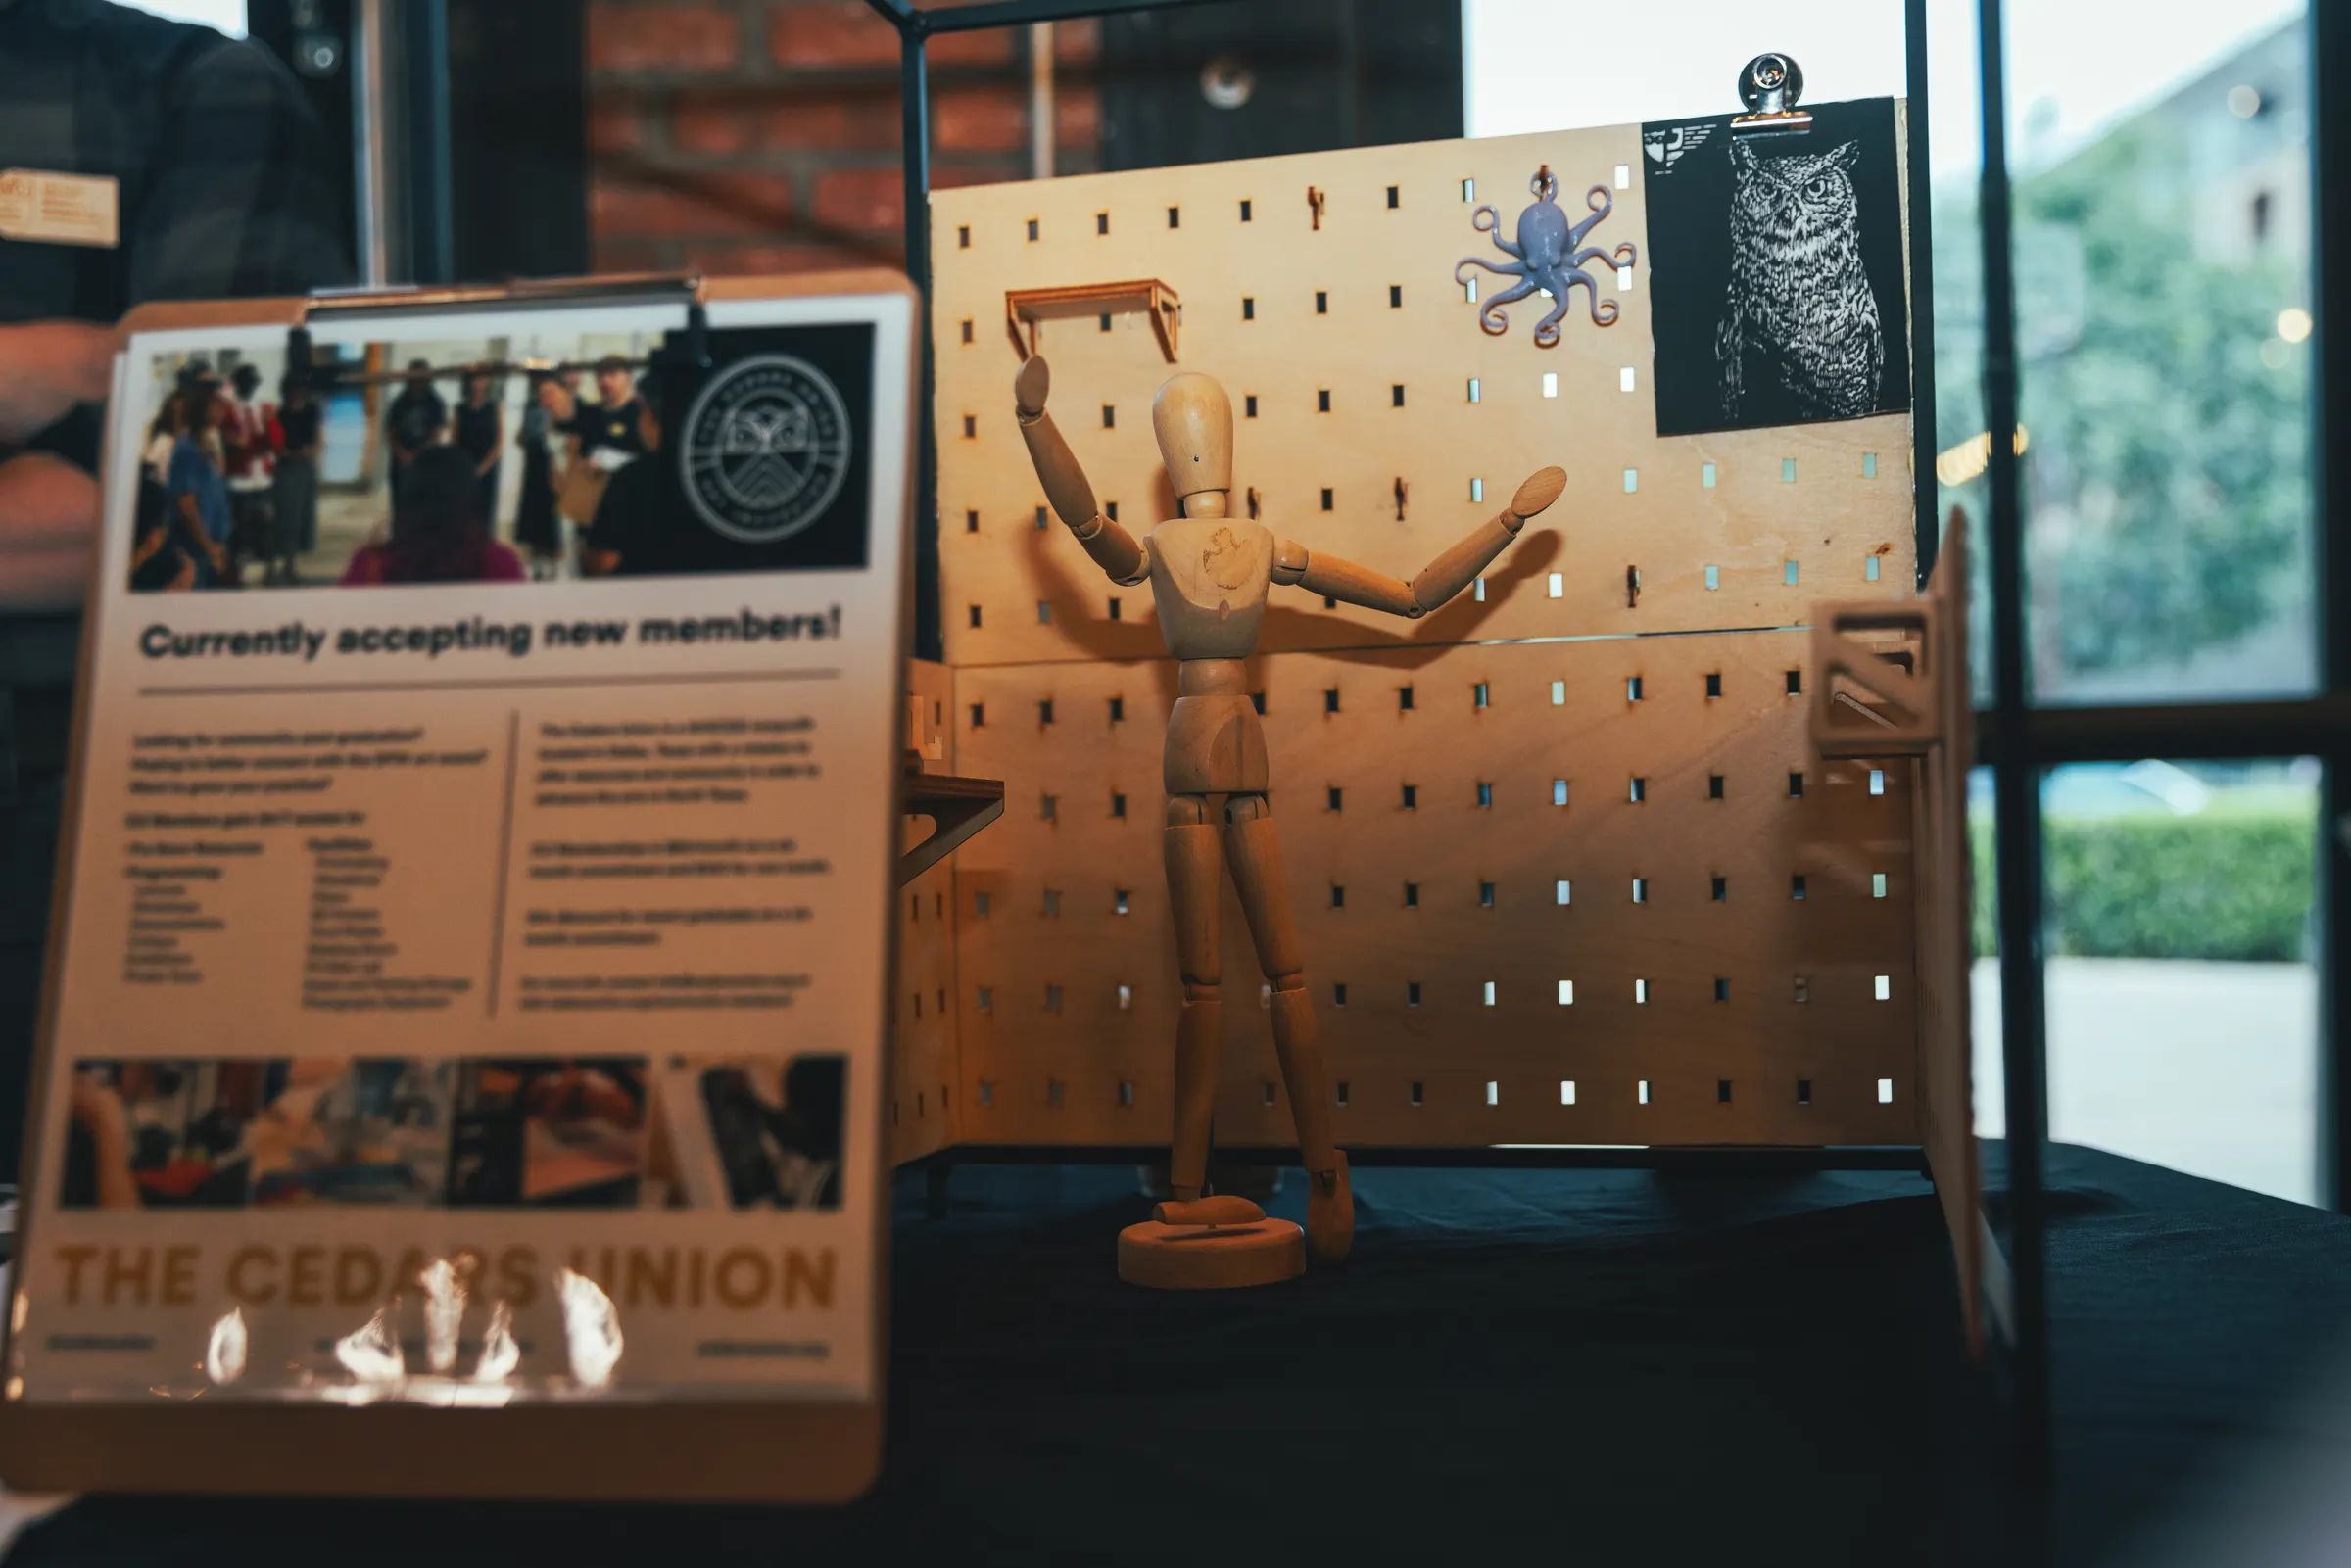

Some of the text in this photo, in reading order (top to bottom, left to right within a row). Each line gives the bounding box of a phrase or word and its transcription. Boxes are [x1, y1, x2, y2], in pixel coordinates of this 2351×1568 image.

[139, 605, 841, 662] Currently accepting new members!
[53, 1245, 201, 1307] THE
